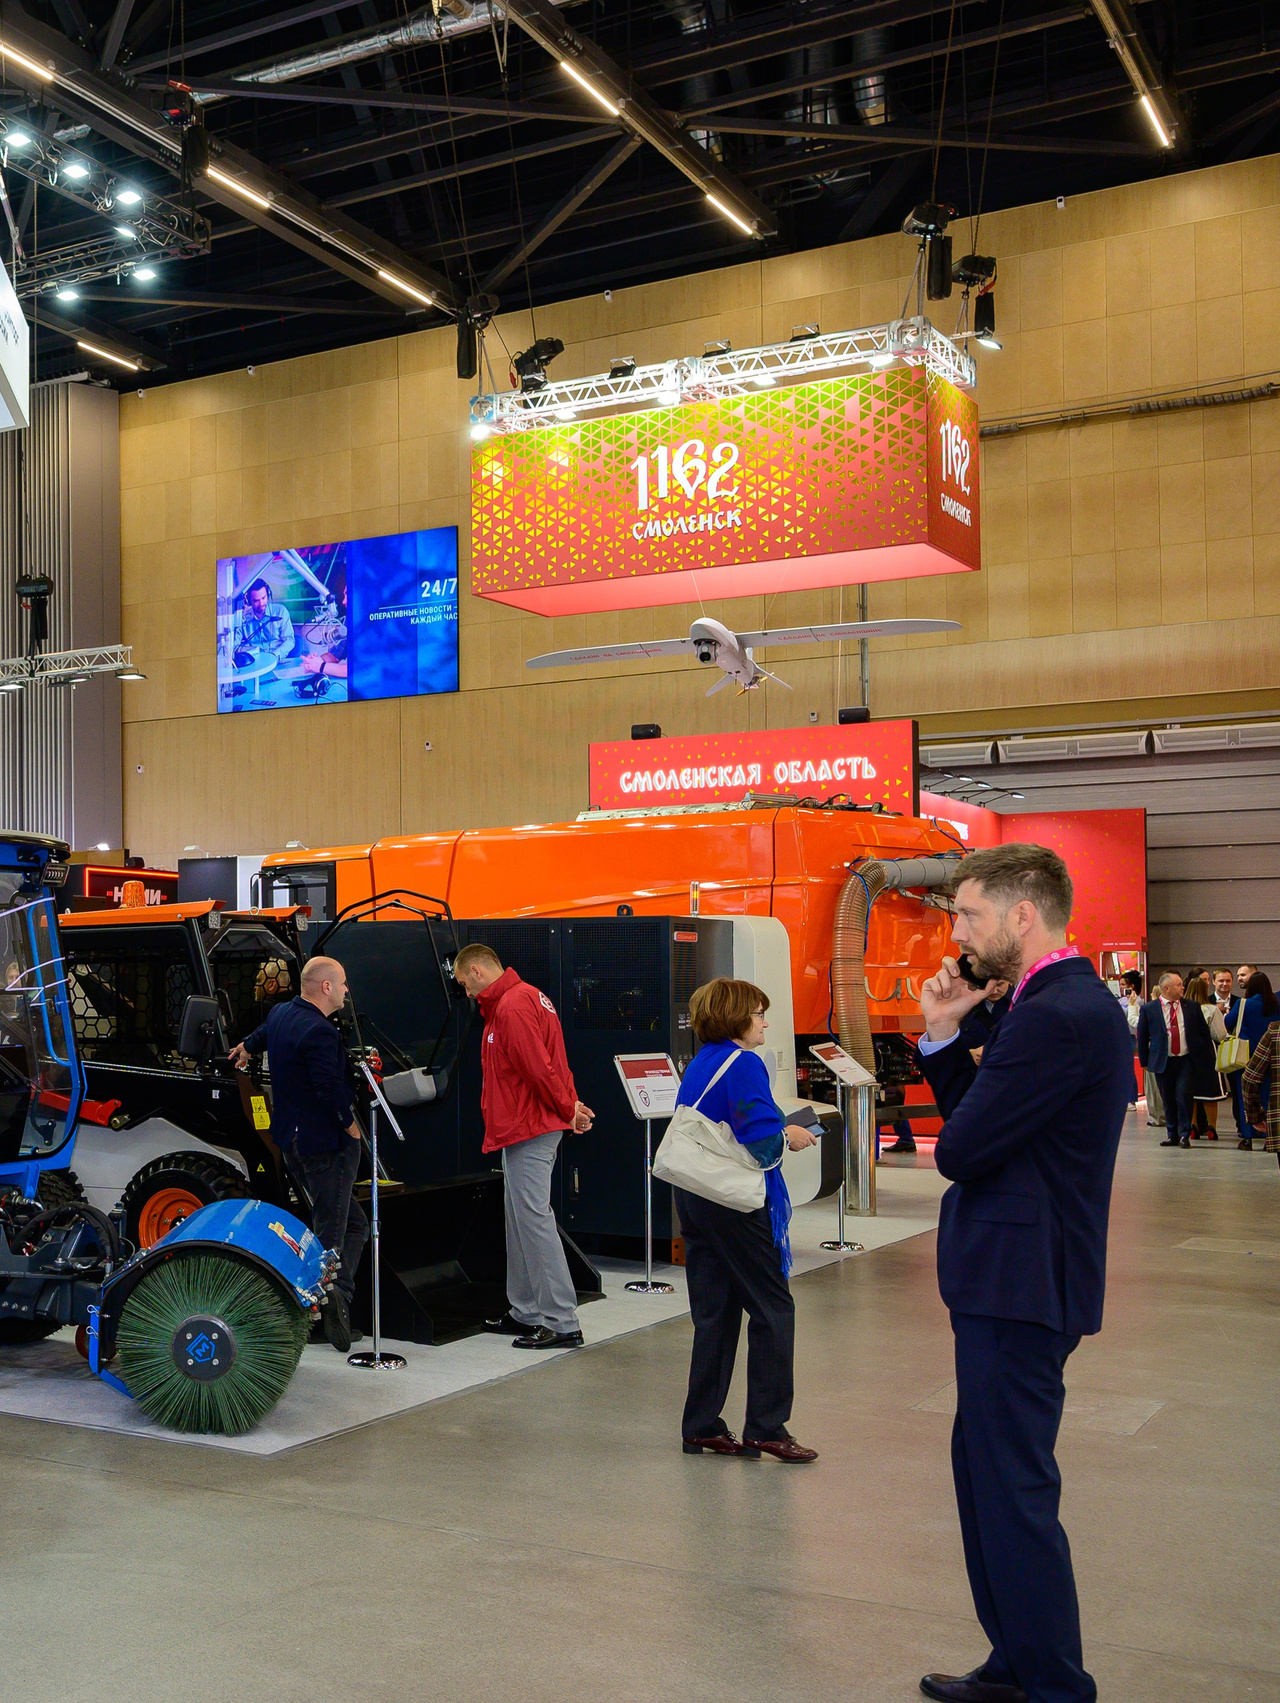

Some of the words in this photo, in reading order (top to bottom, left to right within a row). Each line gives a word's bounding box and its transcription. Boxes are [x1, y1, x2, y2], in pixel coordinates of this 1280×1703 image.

[940, 418, 970, 496] 1162
[630, 438, 740, 511] 1162
[632, 508, 743, 541] СМОЛЕНСК
[940, 492, 972, 527] СМОЛЕНСК
[421, 577, 457, 598] 24/7
[369, 608, 418, 621] ОПЕРАТИВНЫЕ
[419, 604, 452, 615] НОВОСТИ
[410, 614, 442, 625] КАЖДЫЙ
[444, 612, 458, 620] ЧАС
[619, 763, 762, 793] СМОЛЕНСКАЯ
[773, 757, 877, 784] ОБЛАСТЬ
